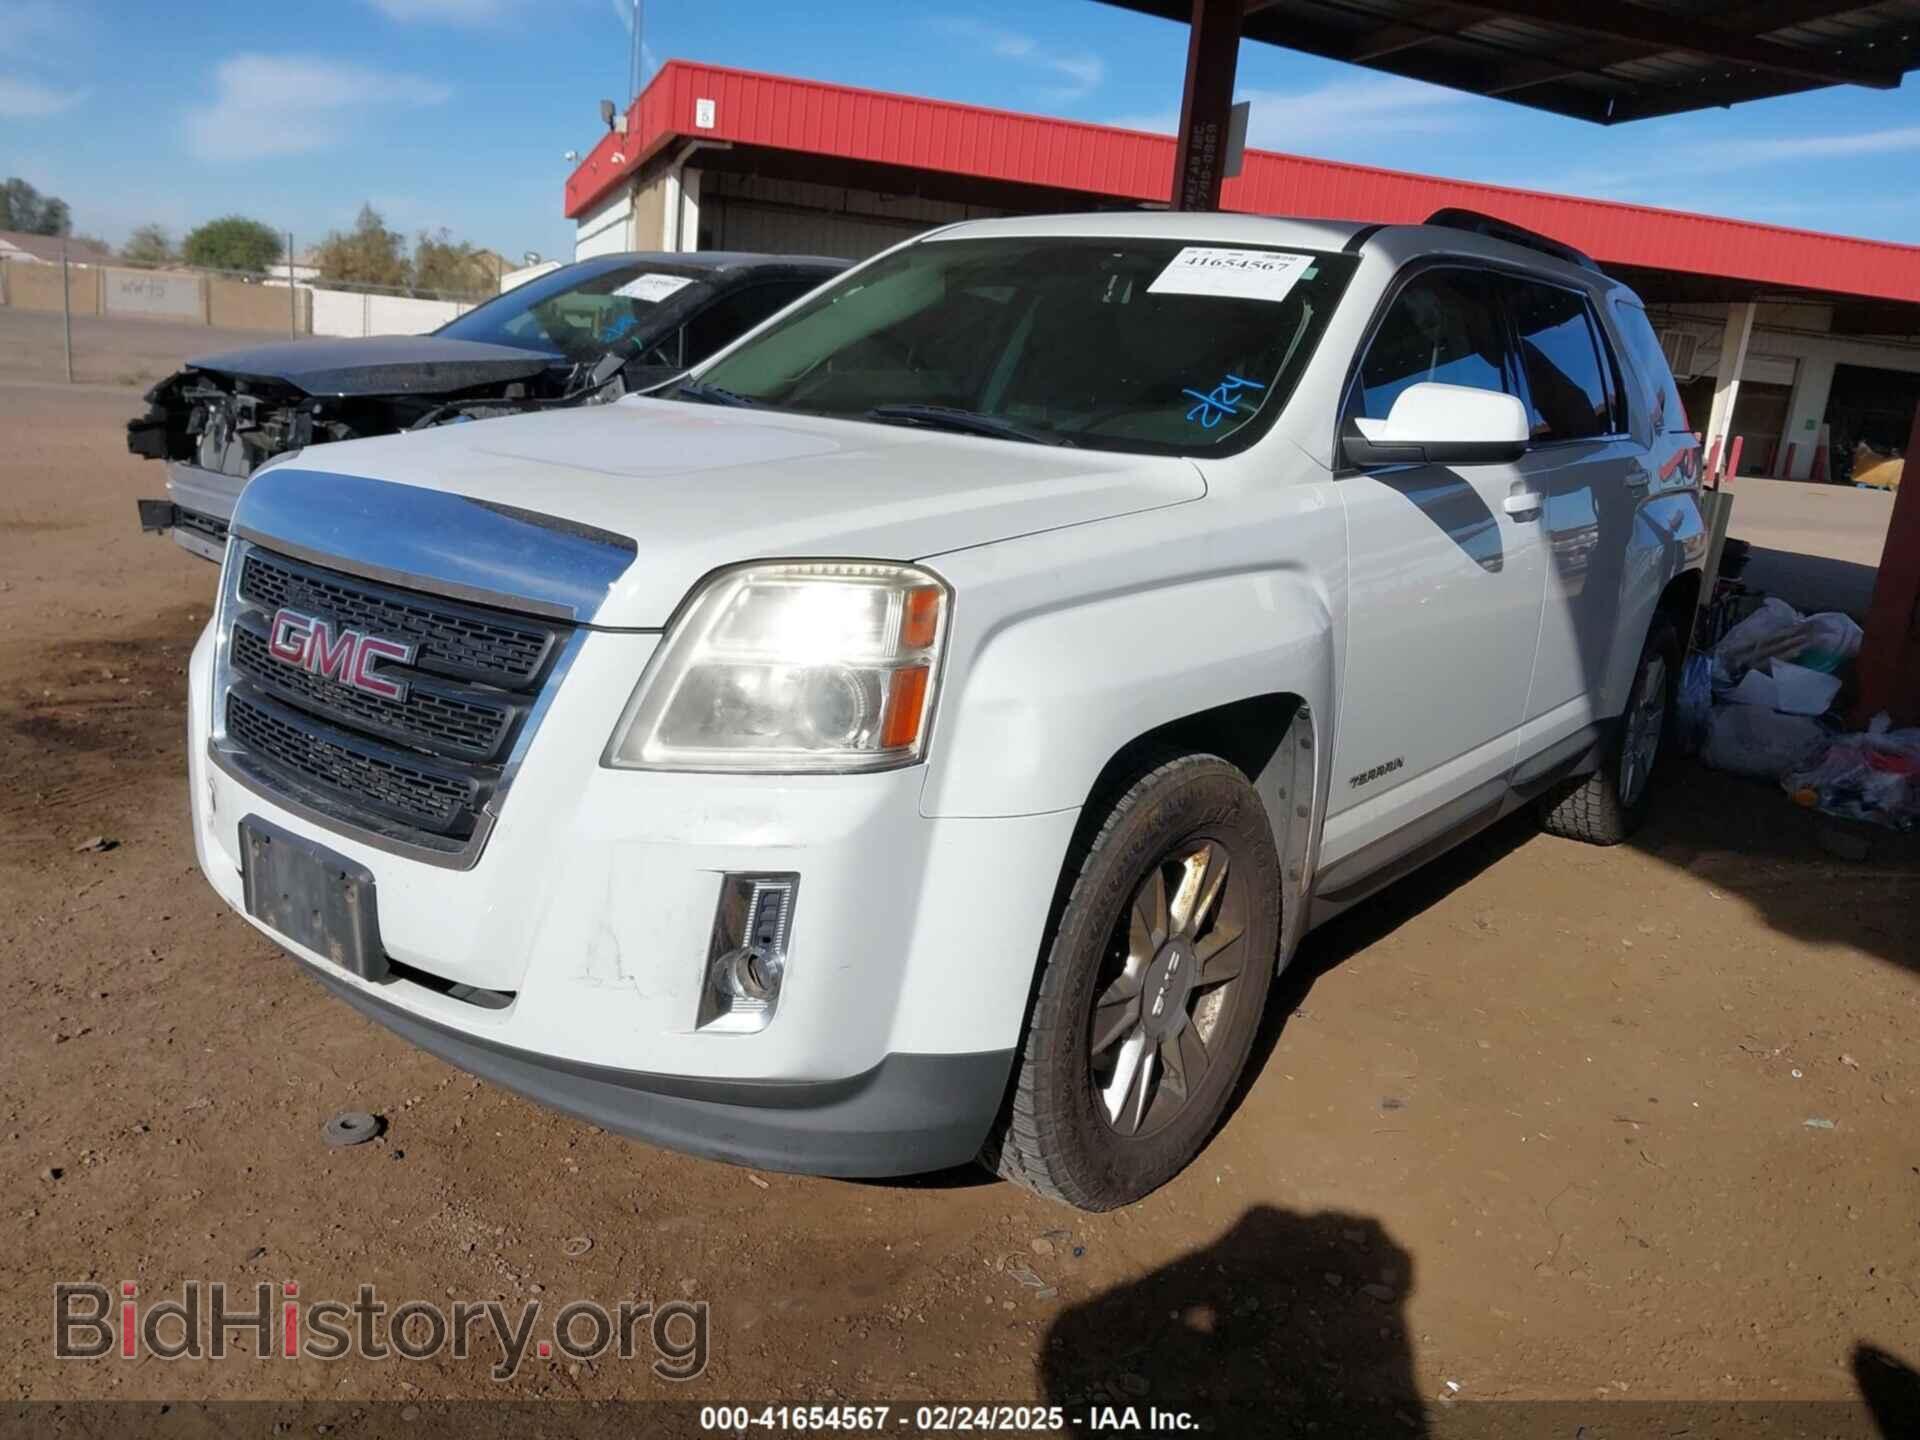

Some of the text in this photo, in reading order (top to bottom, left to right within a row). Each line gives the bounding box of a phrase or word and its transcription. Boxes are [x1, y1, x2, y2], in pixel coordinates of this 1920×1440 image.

[1184, 257, 1290, 273] 41654567
[1182, 374, 1265, 428] 2/24
[269, 608, 418, 702] GMC
[1349, 755, 1405, 789] TERRAIN
